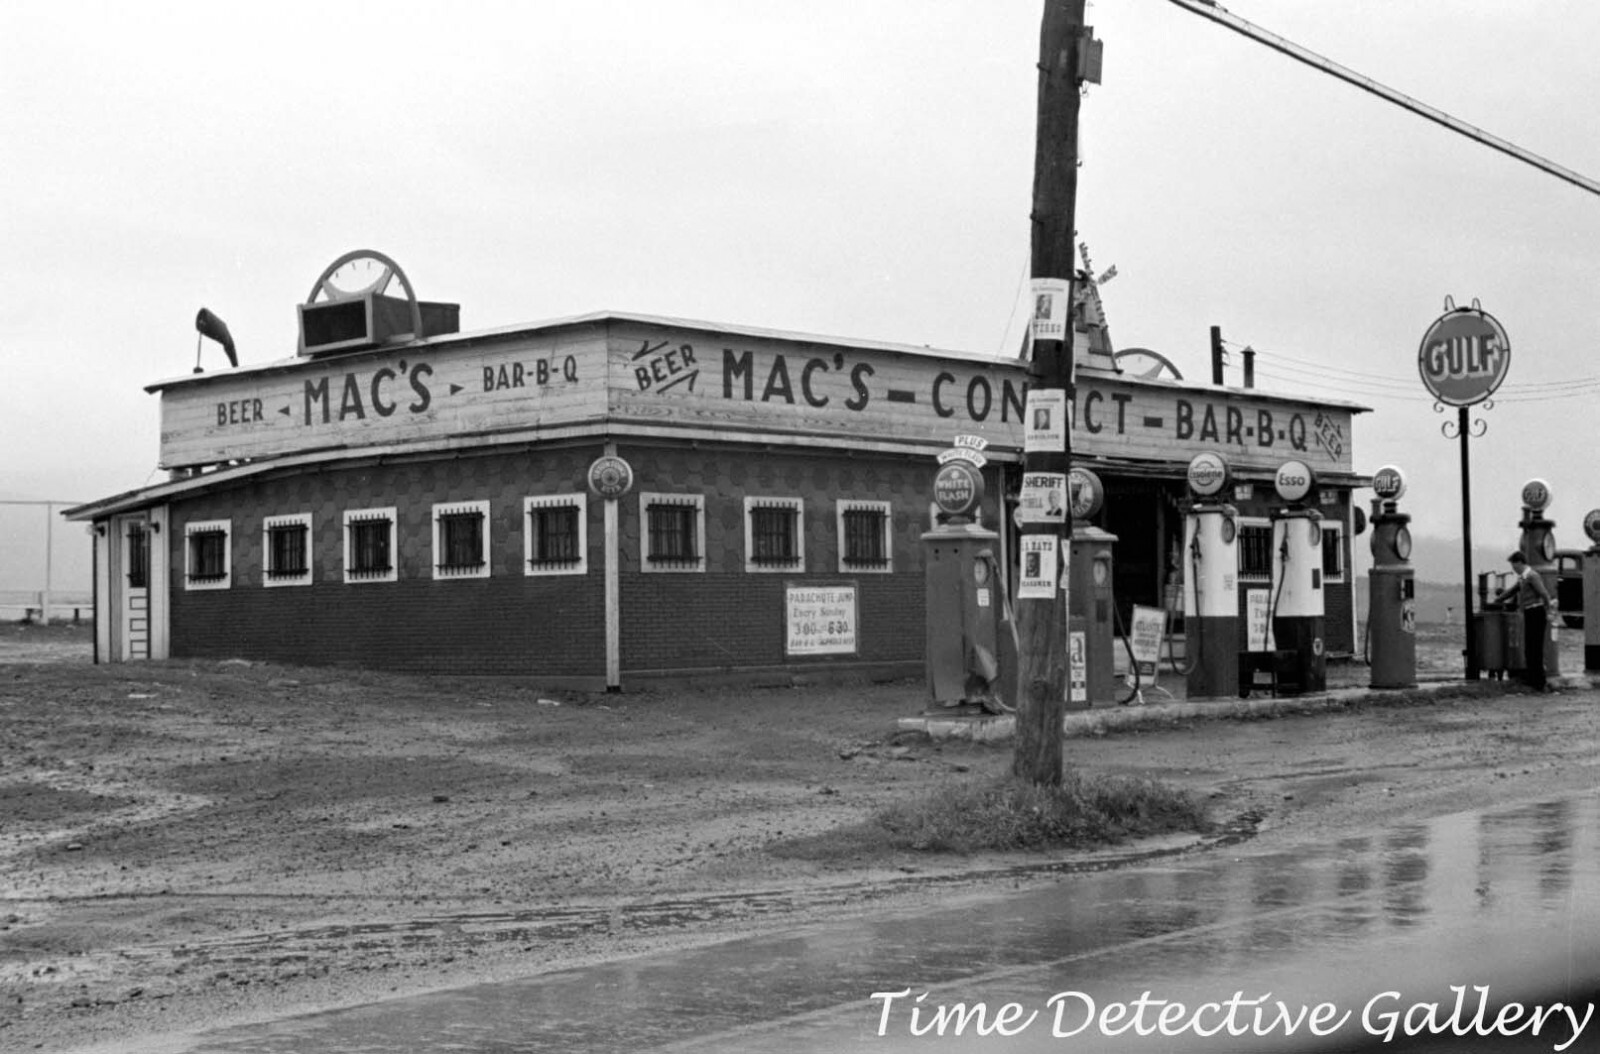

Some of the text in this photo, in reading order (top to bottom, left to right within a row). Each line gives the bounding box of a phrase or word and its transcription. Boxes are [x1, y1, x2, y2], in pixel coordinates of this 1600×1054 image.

[634, 344, 697, 392] BEER
[1425, 334, 1500, 381] GULF
[483, 353, 579, 393] BAR-B-Q
[303, 360, 434, 427] MAC'S
[722, 348, 1309, 453] MAC'S CONICT BAR-B-Q
[216, 398, 264, 427] BEER
[958, 436, 984, 448] PLUS
[1313, 411, 1343, 459] BEER
[937, 479, 969, 490] WHITE
[1024, 476, 1063, 489] SHERIFF
[1279, 472, 1306, 487] Esso
[1375, 475, 1400, 493] GULF
[938, 490, 969, 502] FLASH
